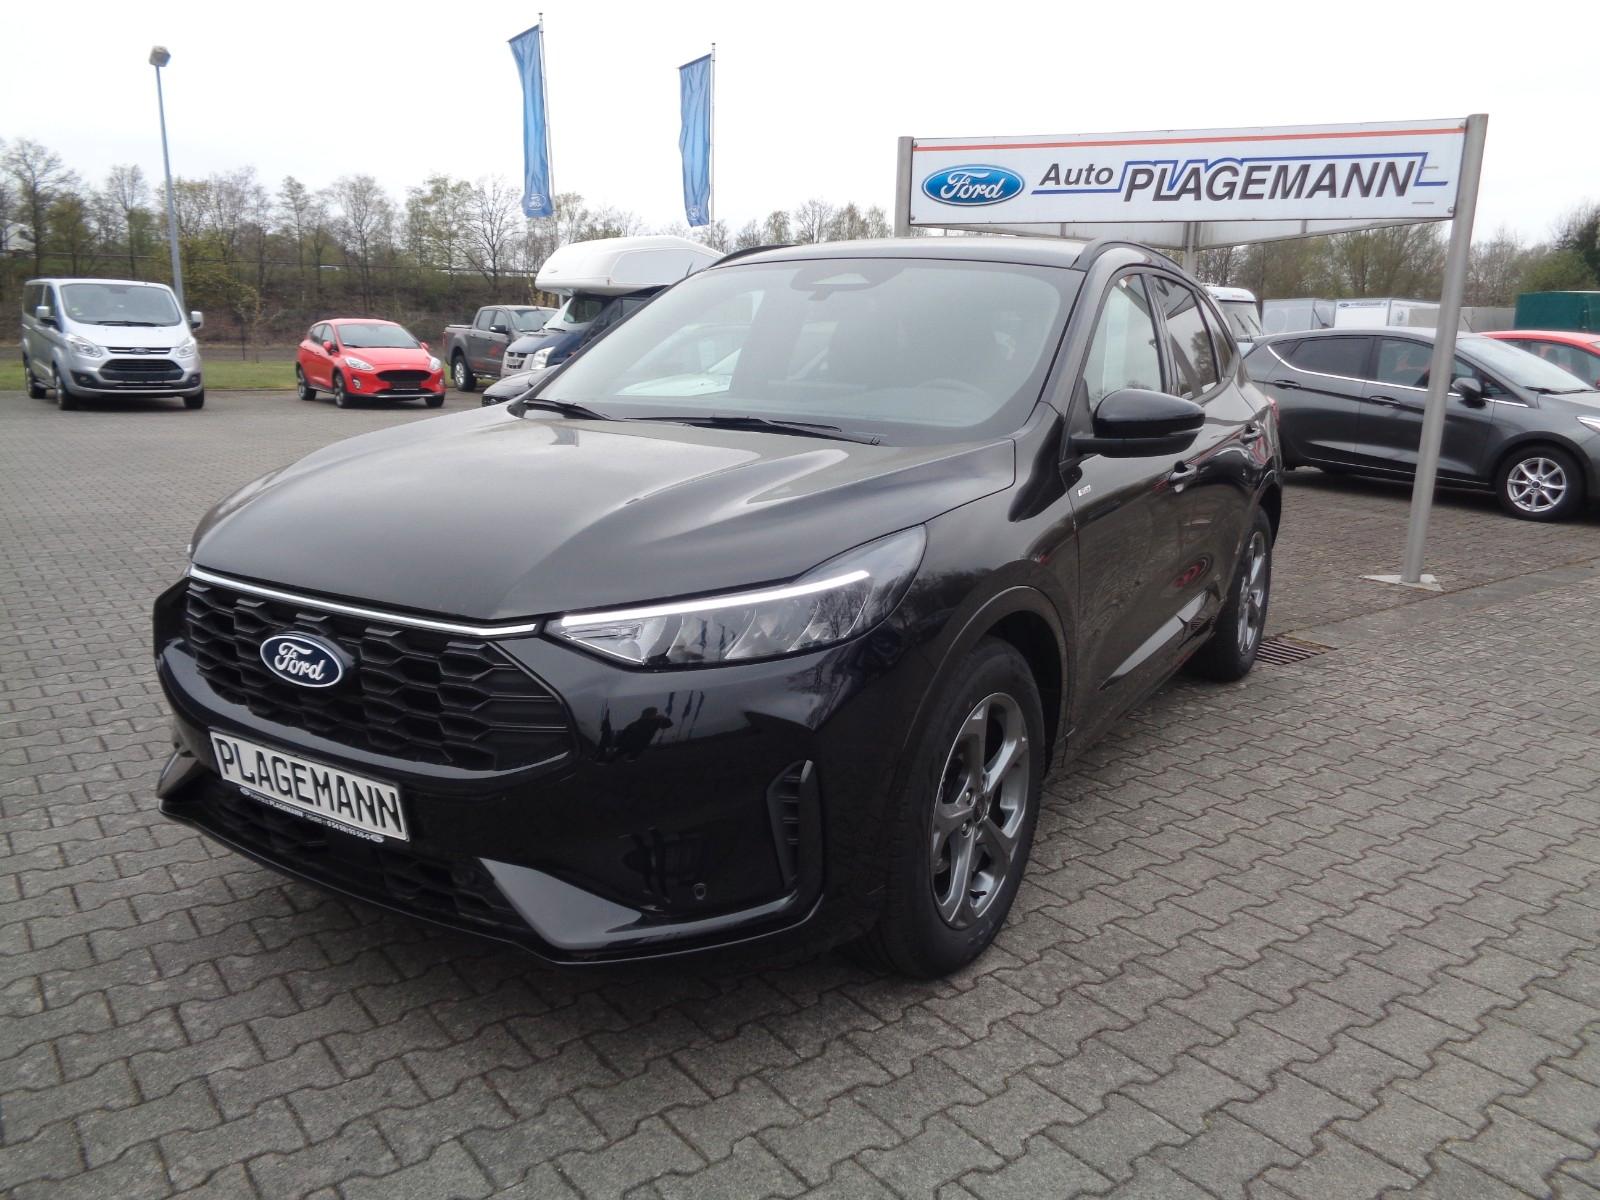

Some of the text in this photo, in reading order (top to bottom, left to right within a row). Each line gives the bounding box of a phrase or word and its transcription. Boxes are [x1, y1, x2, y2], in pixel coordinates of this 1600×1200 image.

[940, 170, 1005, 199] Ford
[1038, 161, 1416, 202] Auto PLAGEMANN
[274, 642, 325, 681] Ford
[213, 737, 403, 833] PLAGEMANN
